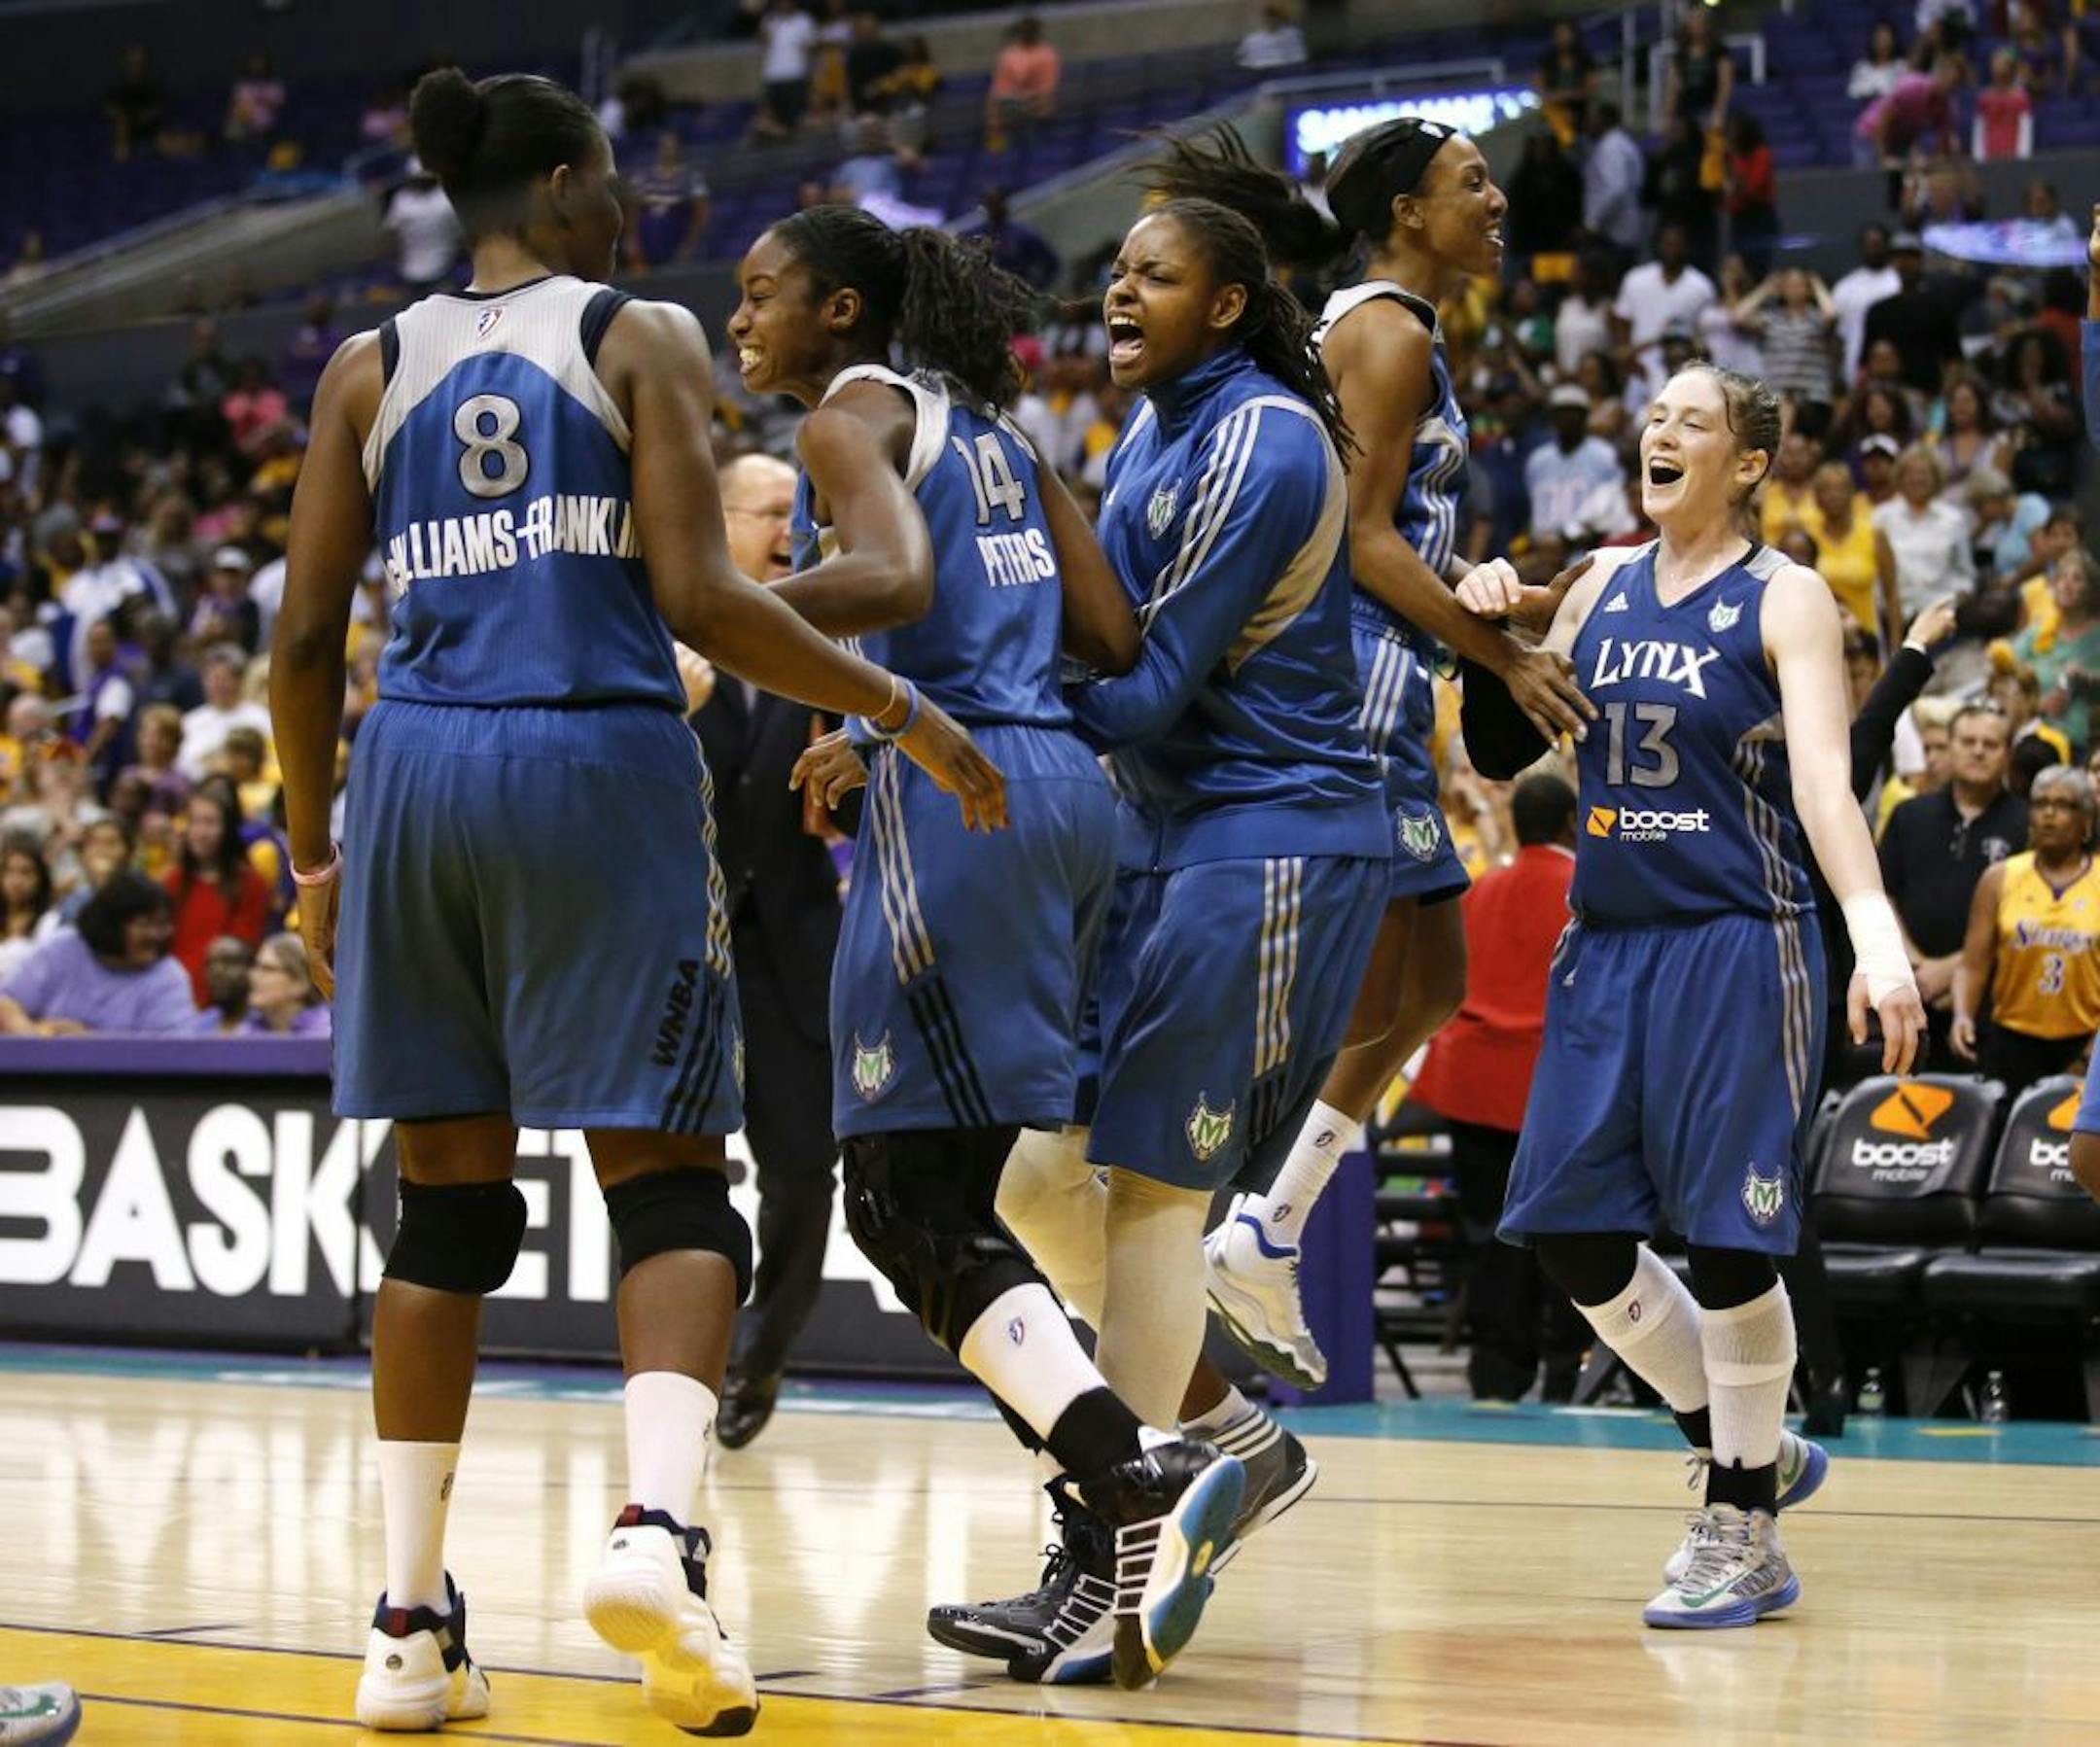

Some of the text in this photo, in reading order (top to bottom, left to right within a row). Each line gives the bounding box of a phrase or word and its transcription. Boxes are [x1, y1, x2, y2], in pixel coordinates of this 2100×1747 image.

[454, 394, 529, 499] 8
[951, 431, 1026, 526] 14
[976, 528, 1056, 587] PETERS
[1590, 637, 1721, 701] LYNX
[1603, 701, 1680, 789] 13
[1620, 806, 1710, 832] boost
[1620, 830, 1667, 842] mobile
[2037, 953, 2064, 996] 3
[650, 959, 700, 1068] WNBA
[1851, 1136, 1954, 1168] boost
[1871, 1169, 1929, 1183] mobile
